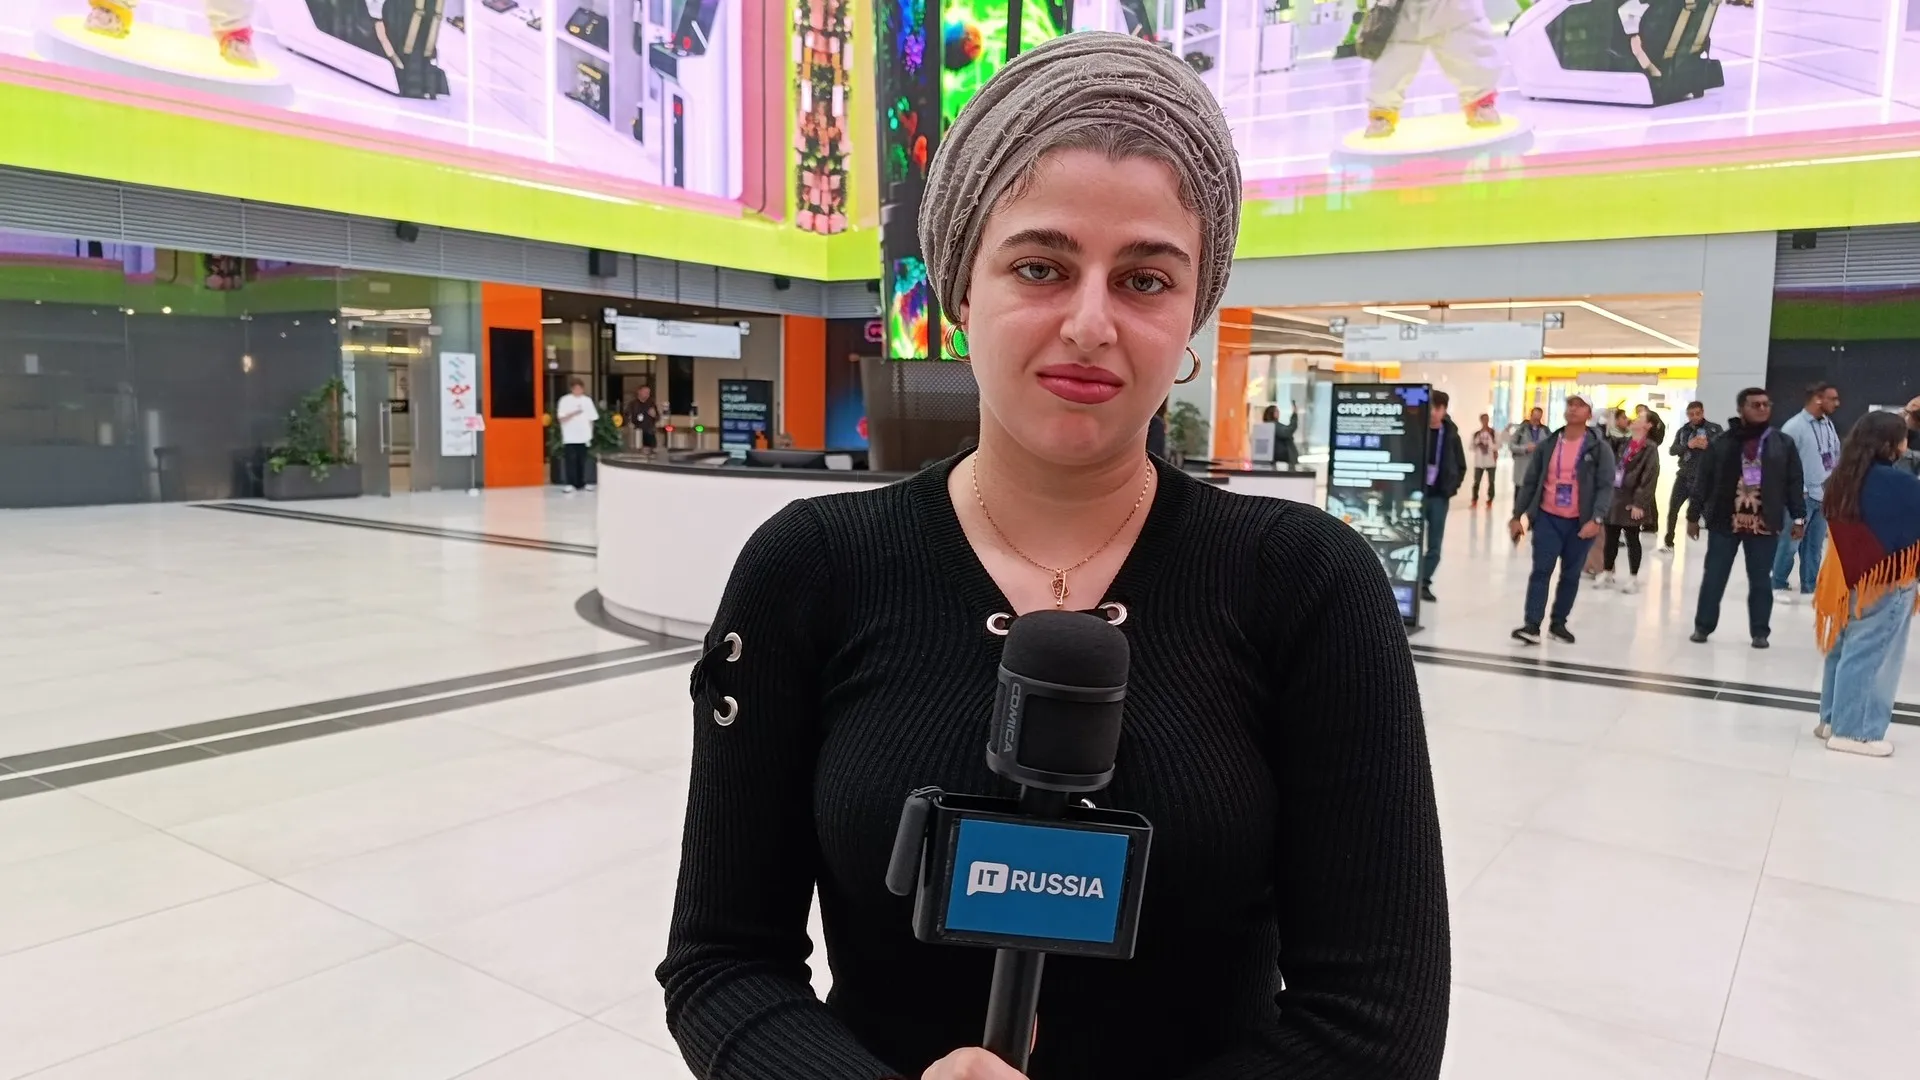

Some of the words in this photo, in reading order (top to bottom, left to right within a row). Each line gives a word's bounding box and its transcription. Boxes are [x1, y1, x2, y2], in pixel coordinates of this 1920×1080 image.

[1003, 682, 1021, 753] COMICA
[977, 869, 1000, 887] IT
[1010, 869, 1104, 899] RUSSIA
